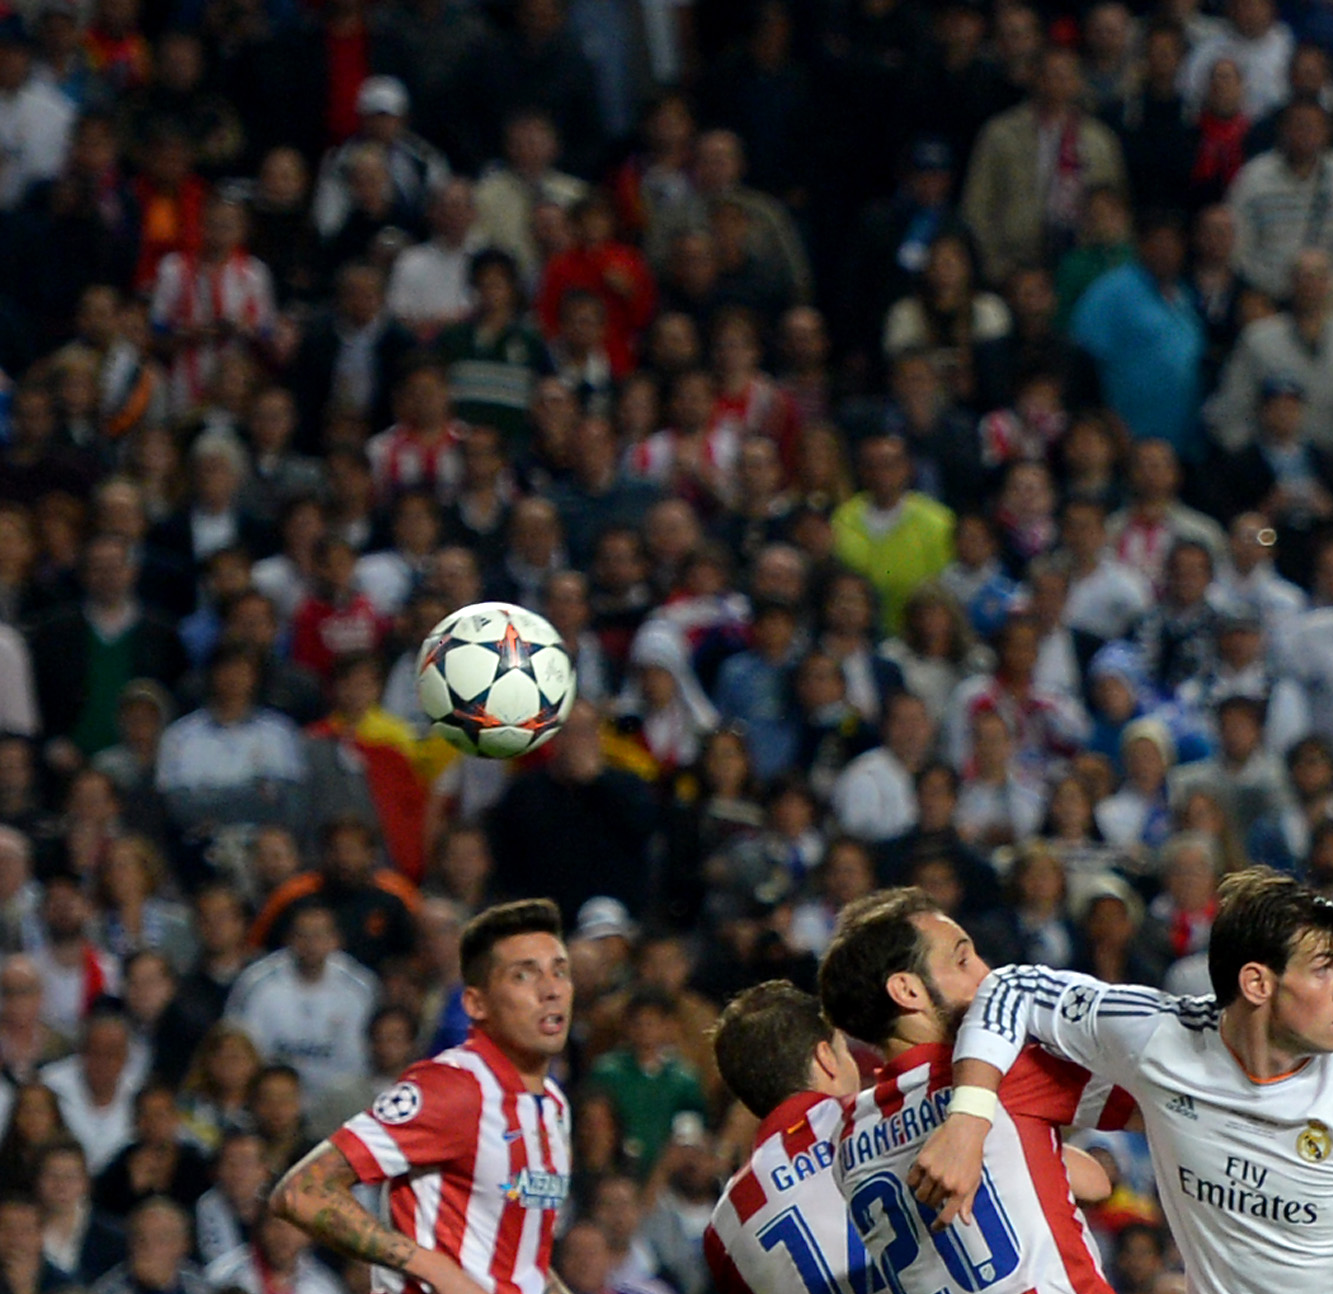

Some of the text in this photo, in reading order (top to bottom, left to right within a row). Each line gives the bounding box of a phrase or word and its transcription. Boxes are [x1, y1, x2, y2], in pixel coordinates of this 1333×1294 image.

[841, 1087, 954, 1172] UANFRAN
[771, 1140, 836, 1192] GAB
[1225, 1155, 1268, 1188] Fly
[1177, 1166, 1318, 1225] Emirates
